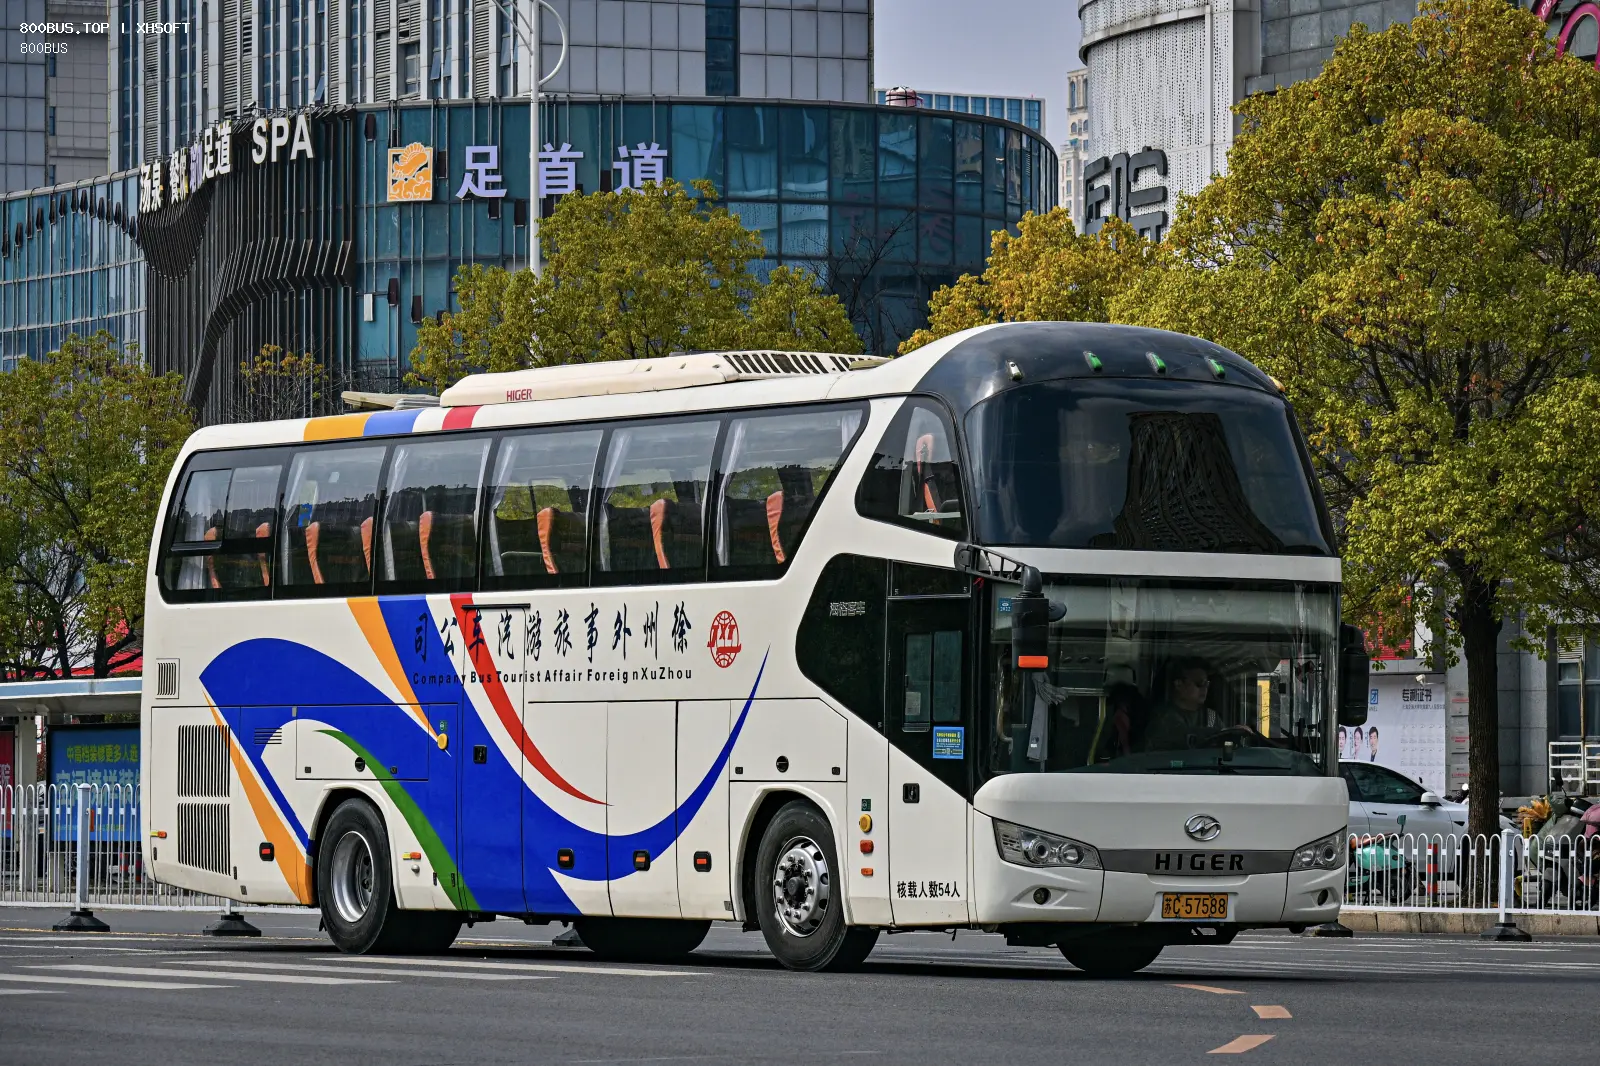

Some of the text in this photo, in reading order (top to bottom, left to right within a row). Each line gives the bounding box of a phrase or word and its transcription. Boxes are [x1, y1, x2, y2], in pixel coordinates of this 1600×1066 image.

[252, 115, 314, 164] SPA
[506, 388, 533, 401] HIGER
[413, 672, 467, 687] Company
[470, 671, 492, 683] Bus
[496, 670, 541, 683] Tourist
[544, 669, 583, 682] Affair
[1155, 853, 1244, 871] HIGER
[897, 880, 961, 898] 核载人数54人
